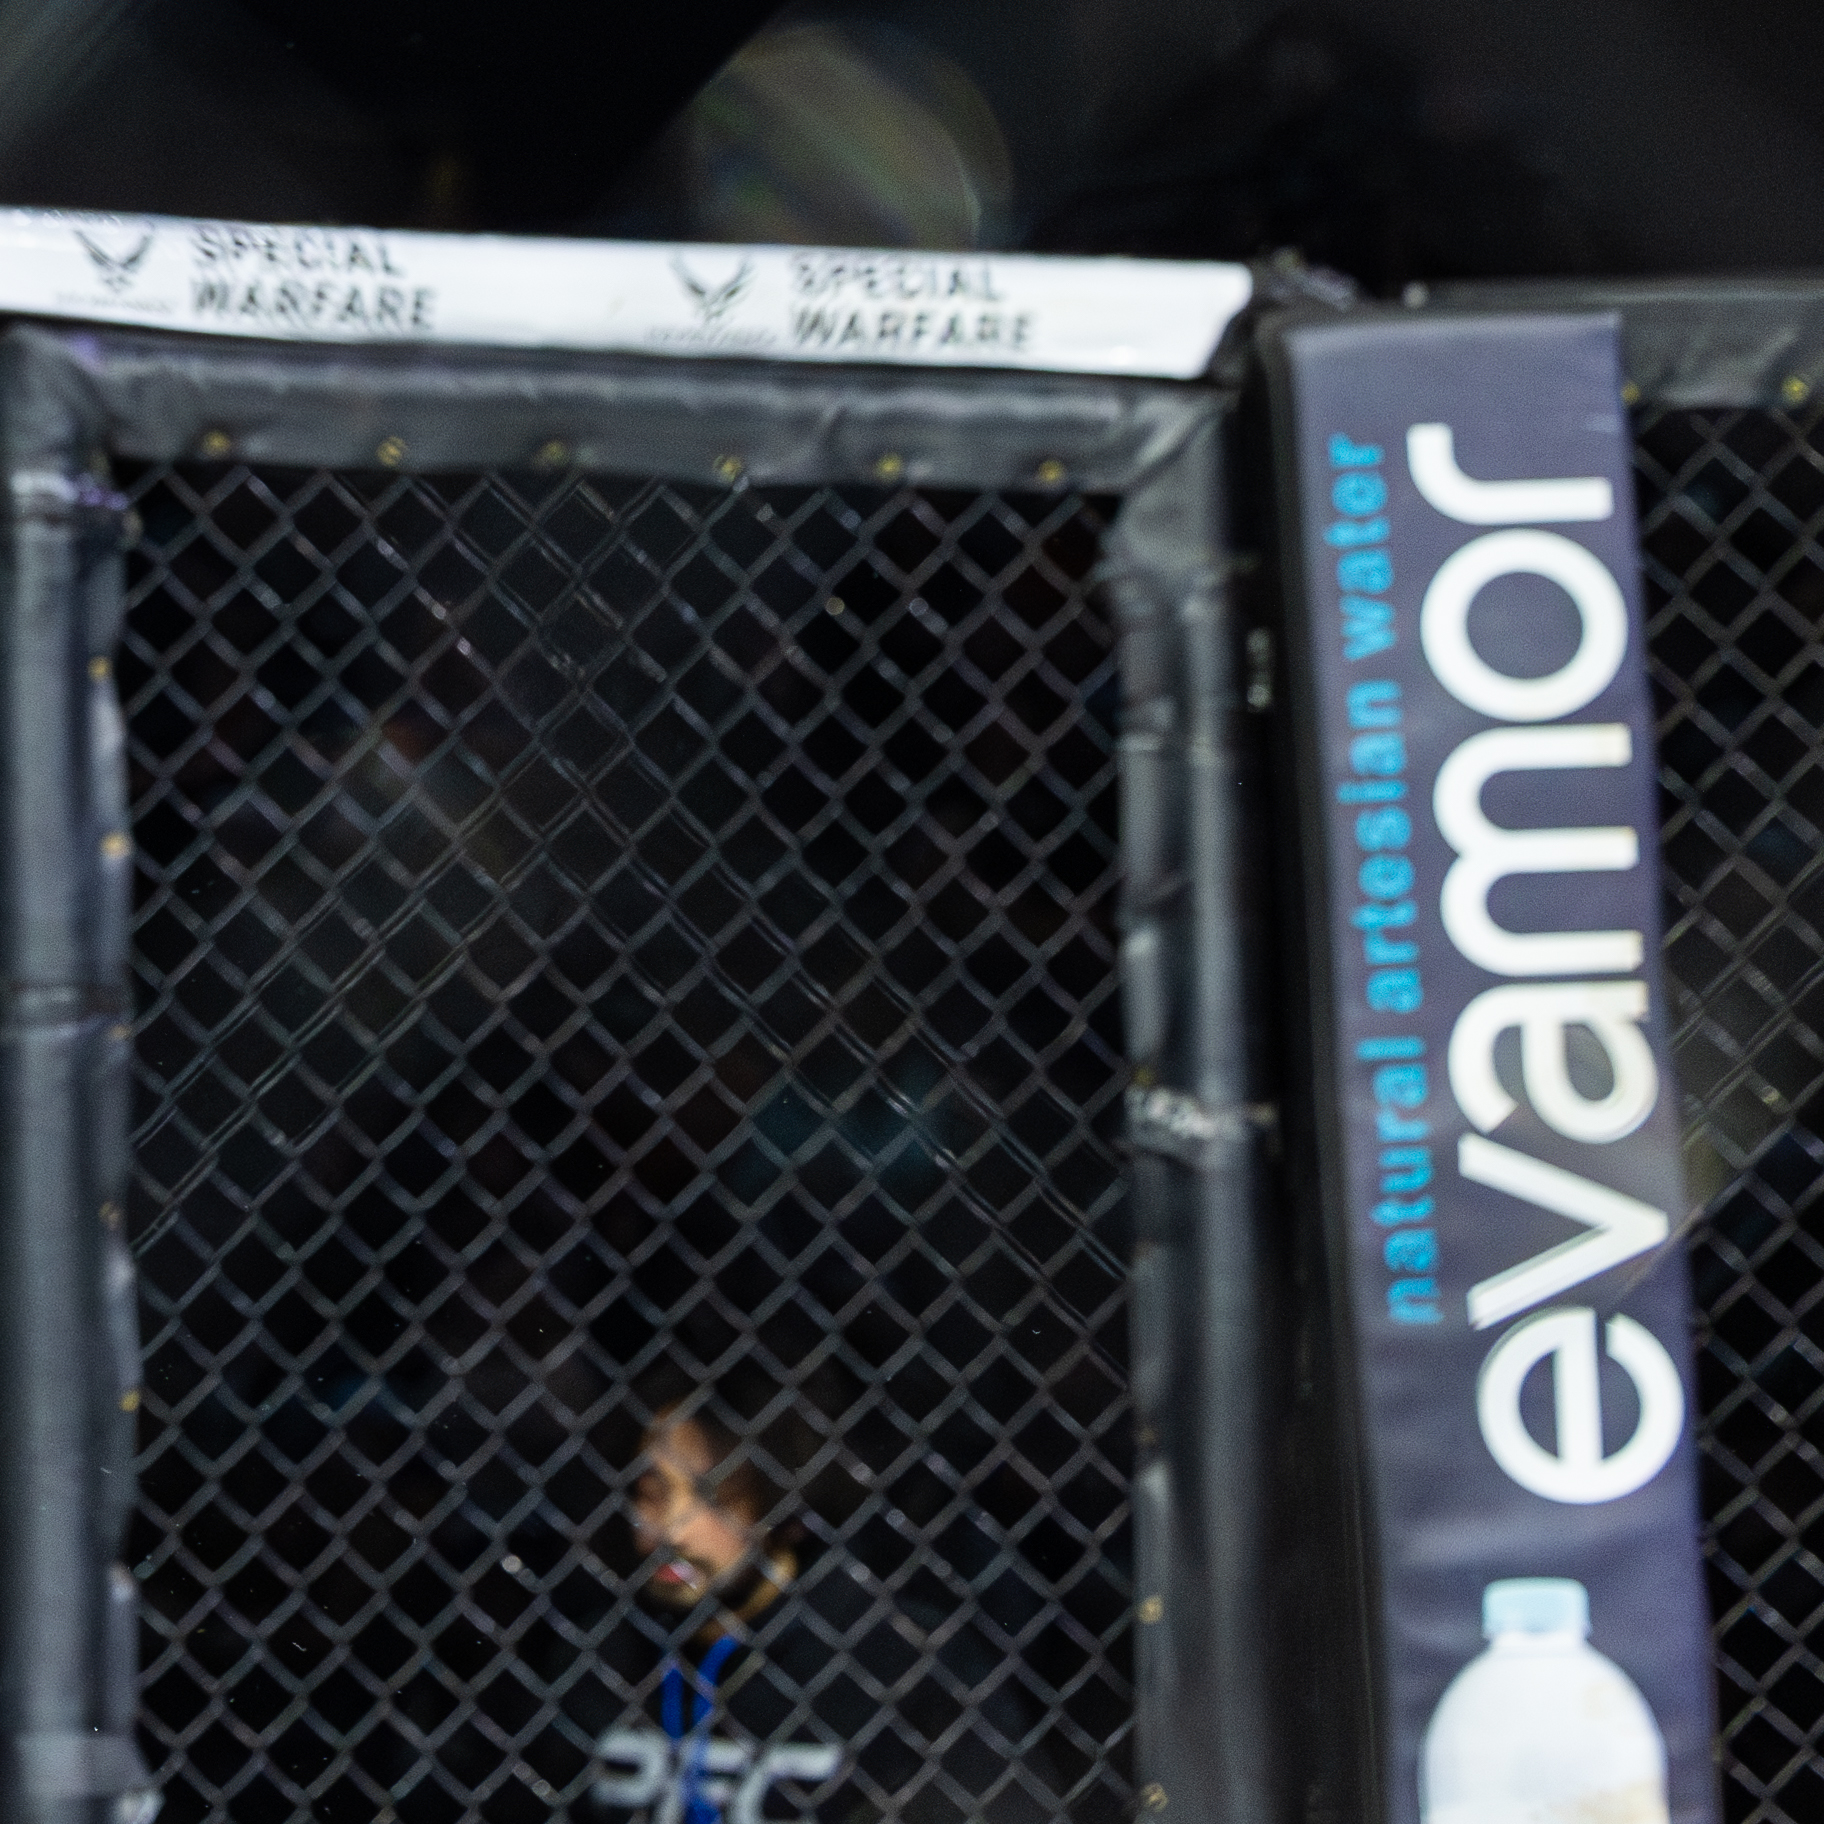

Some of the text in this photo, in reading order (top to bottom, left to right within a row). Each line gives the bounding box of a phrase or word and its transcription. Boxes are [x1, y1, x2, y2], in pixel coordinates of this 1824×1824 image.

[195, 223, 405, 276] SPECIAL
[794, 250, 1002, 300] SPECIAL
[194, 279, 439, 329] WARFARE
[792, 305, 1032, 348] WARFARE
[1323, 433, 1442, 1326] natural artesian water
[1406, 422, 1686, 1506] evamor
